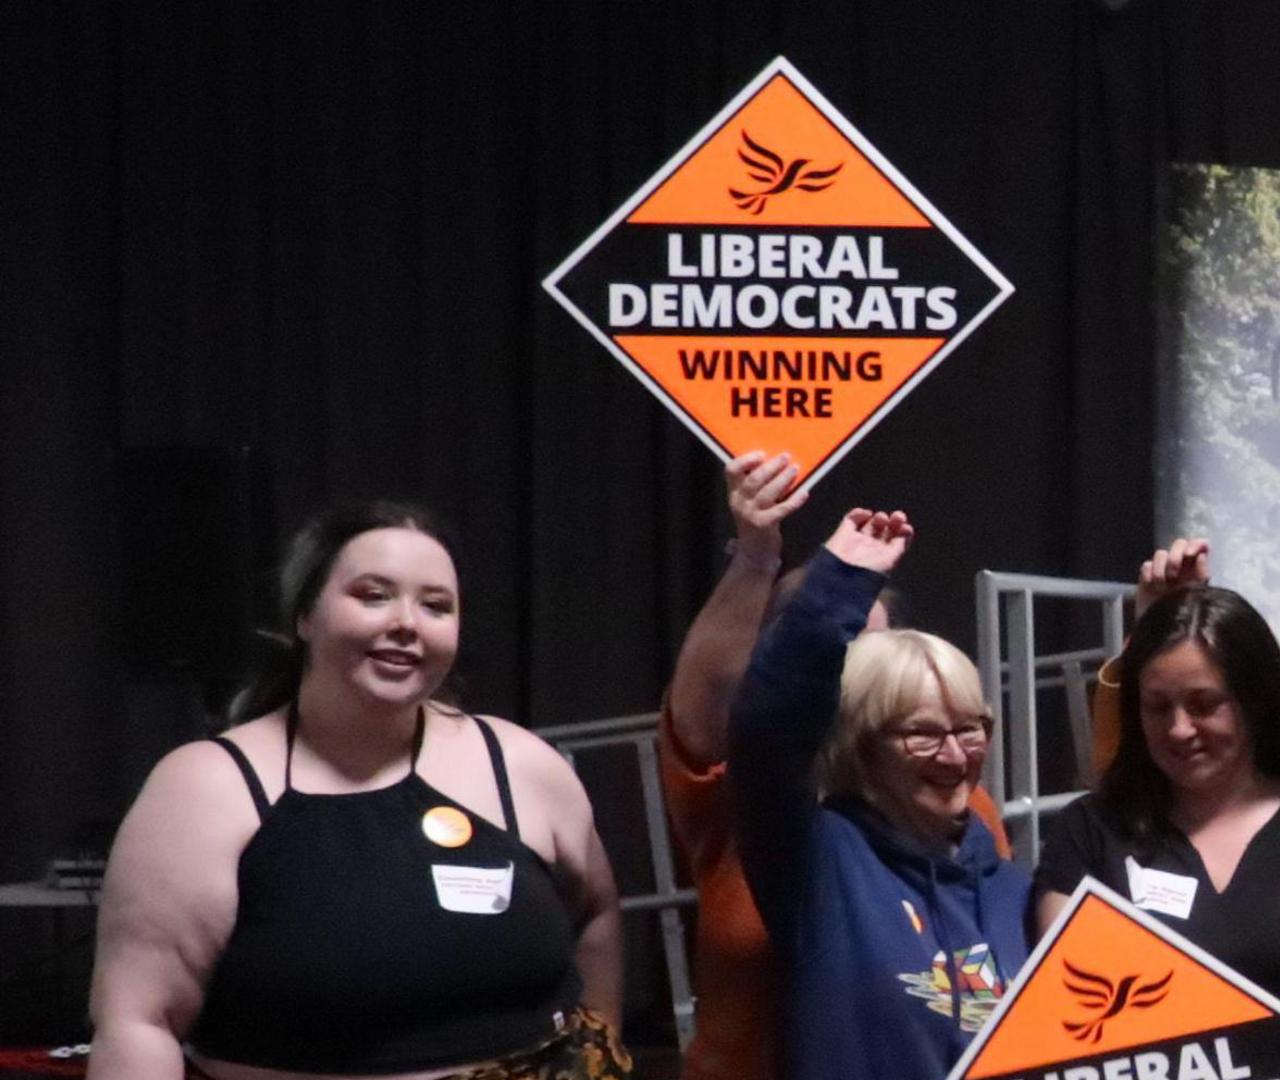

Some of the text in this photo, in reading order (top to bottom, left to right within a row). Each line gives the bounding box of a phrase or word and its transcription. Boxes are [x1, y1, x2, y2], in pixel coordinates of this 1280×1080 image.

[667, 232, 899, 280] LIBERAL
[608, 283, 957, 330] DEMOCRATS
[679, 349, 884, 382] WINNING
[731, 387, 834, 418] HERE
